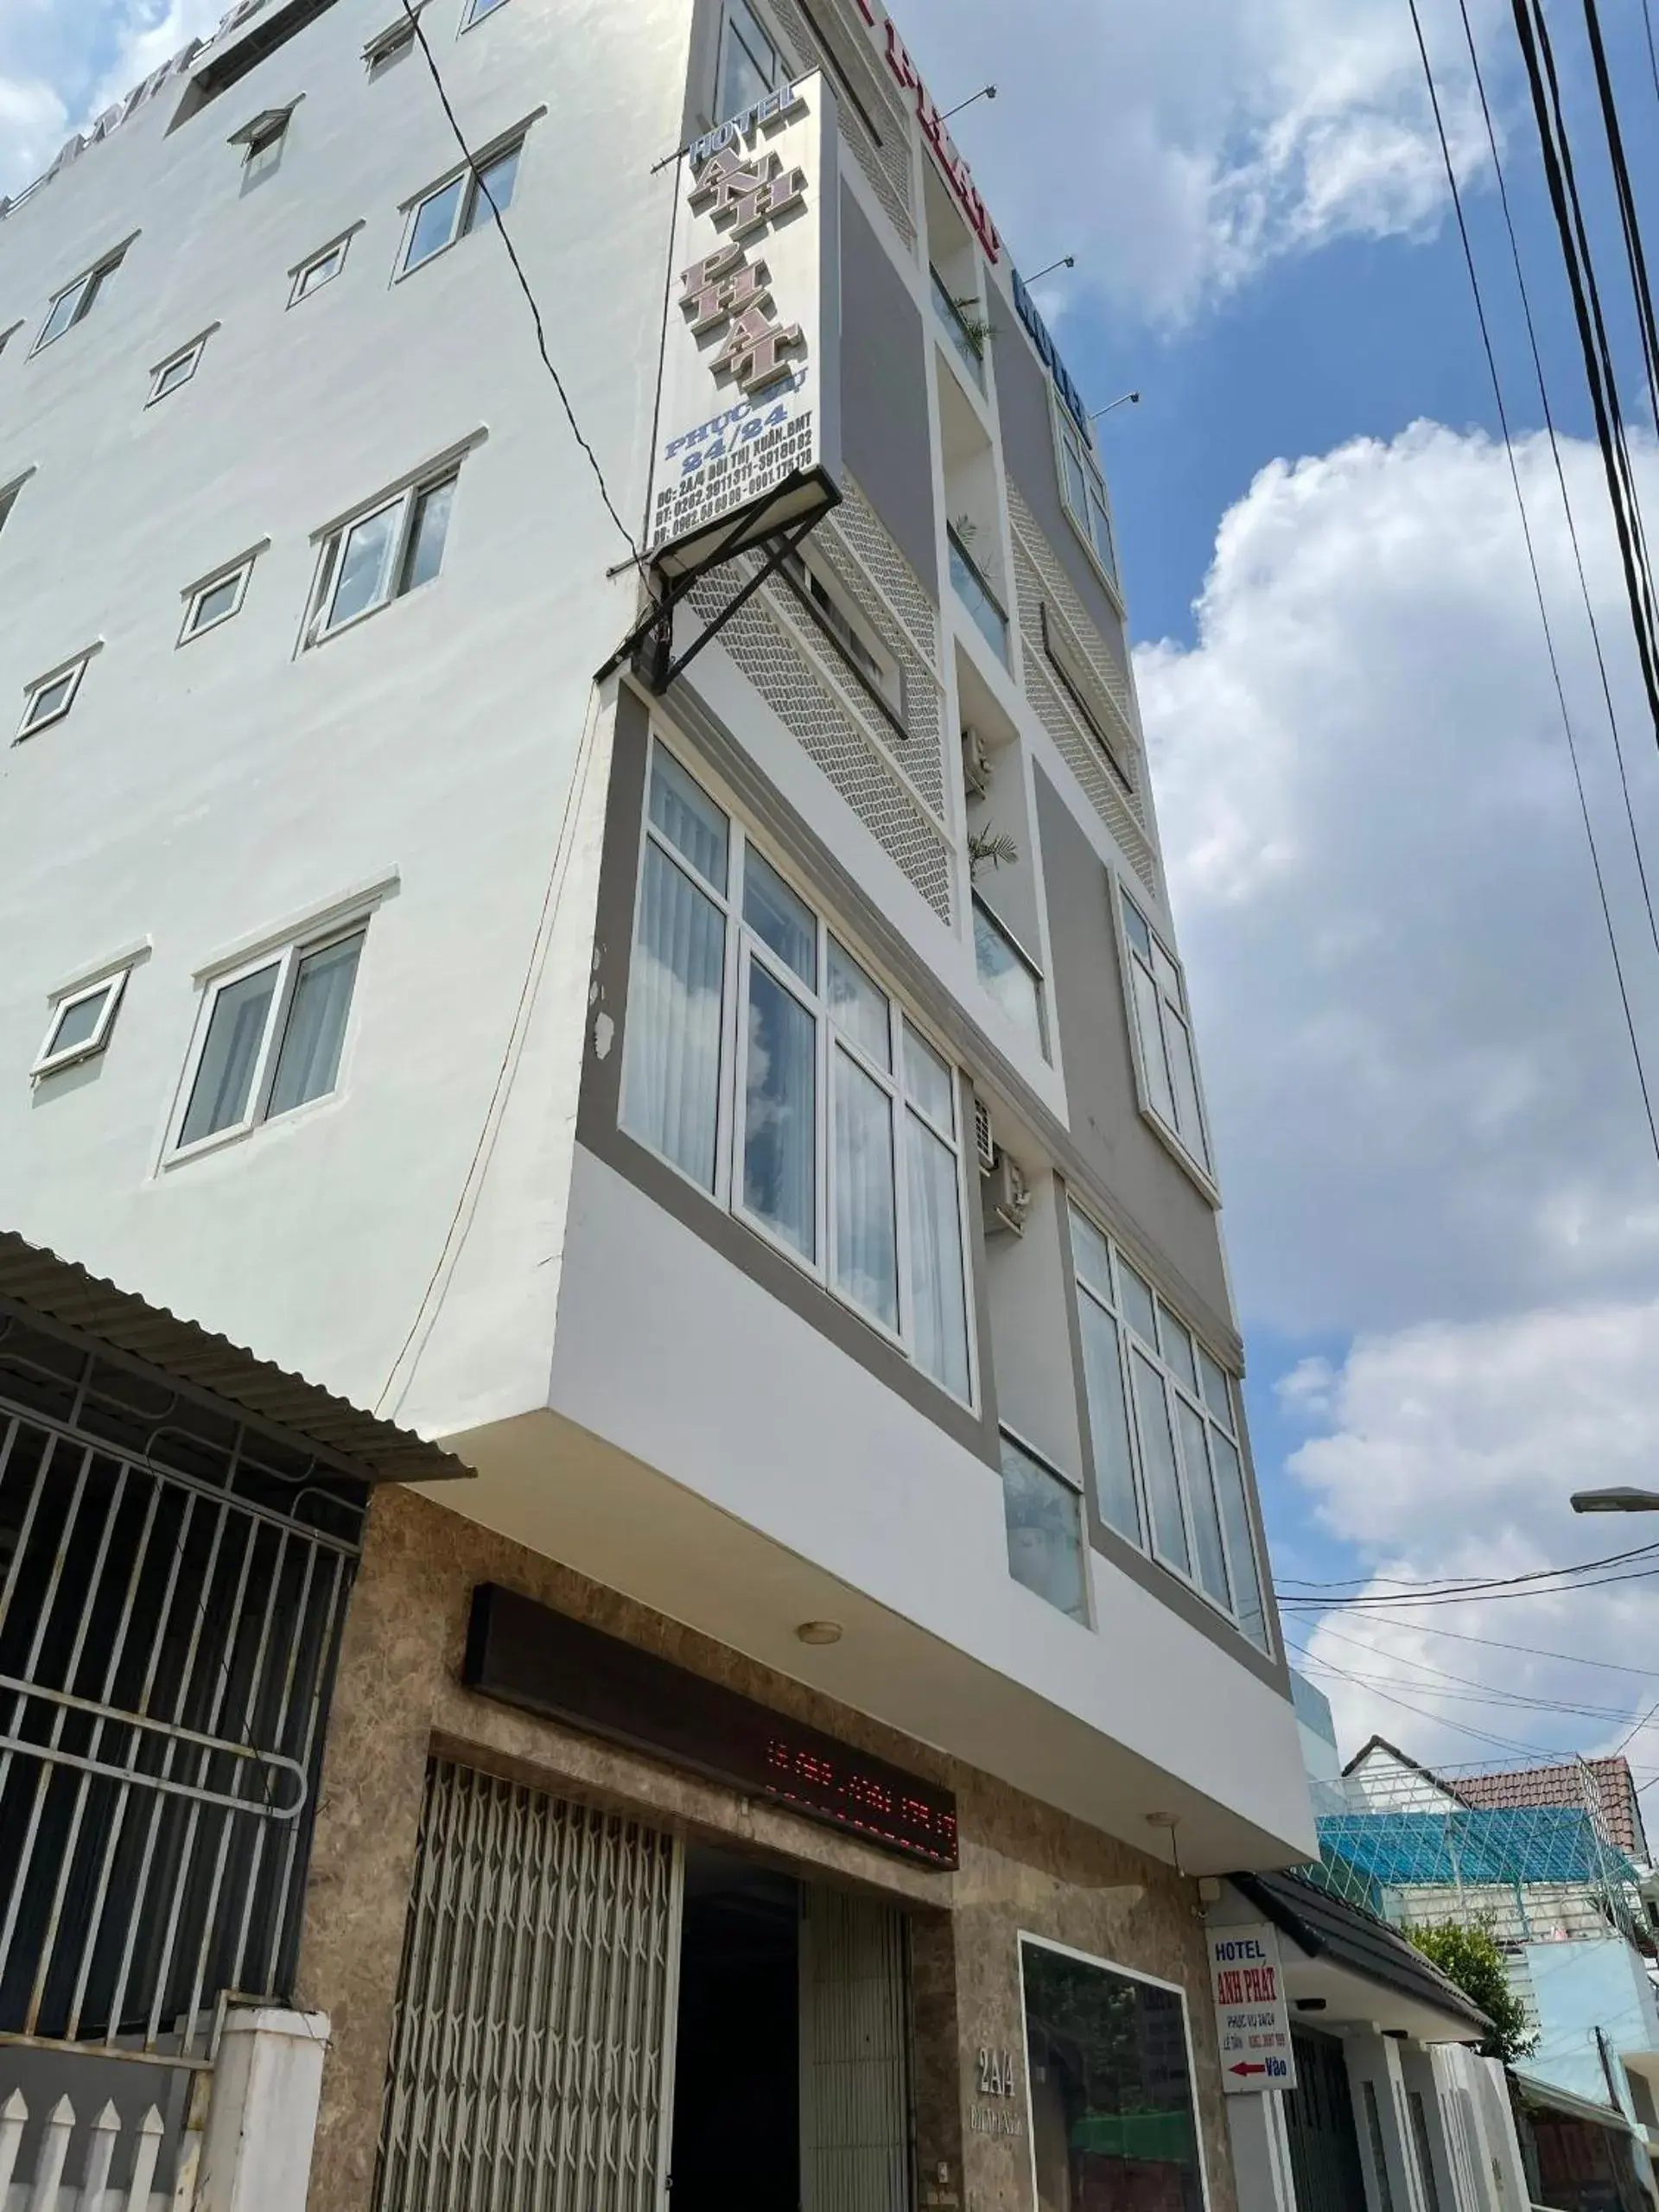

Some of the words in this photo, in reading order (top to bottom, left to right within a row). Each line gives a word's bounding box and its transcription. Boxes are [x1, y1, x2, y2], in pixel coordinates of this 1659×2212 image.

[689, 84, 796, 166] HOTEL
[688, 148, 803, 240] ANH
[664, 401, 753, 461] PHỤC
[682, 404, 788, 475] 24/24
[1215, 1940, 1266, 1961] HOTEL
[1217, 1970, 1243, 2005] ANH
[1243, 1959, 1276, 2003] PHÁT
